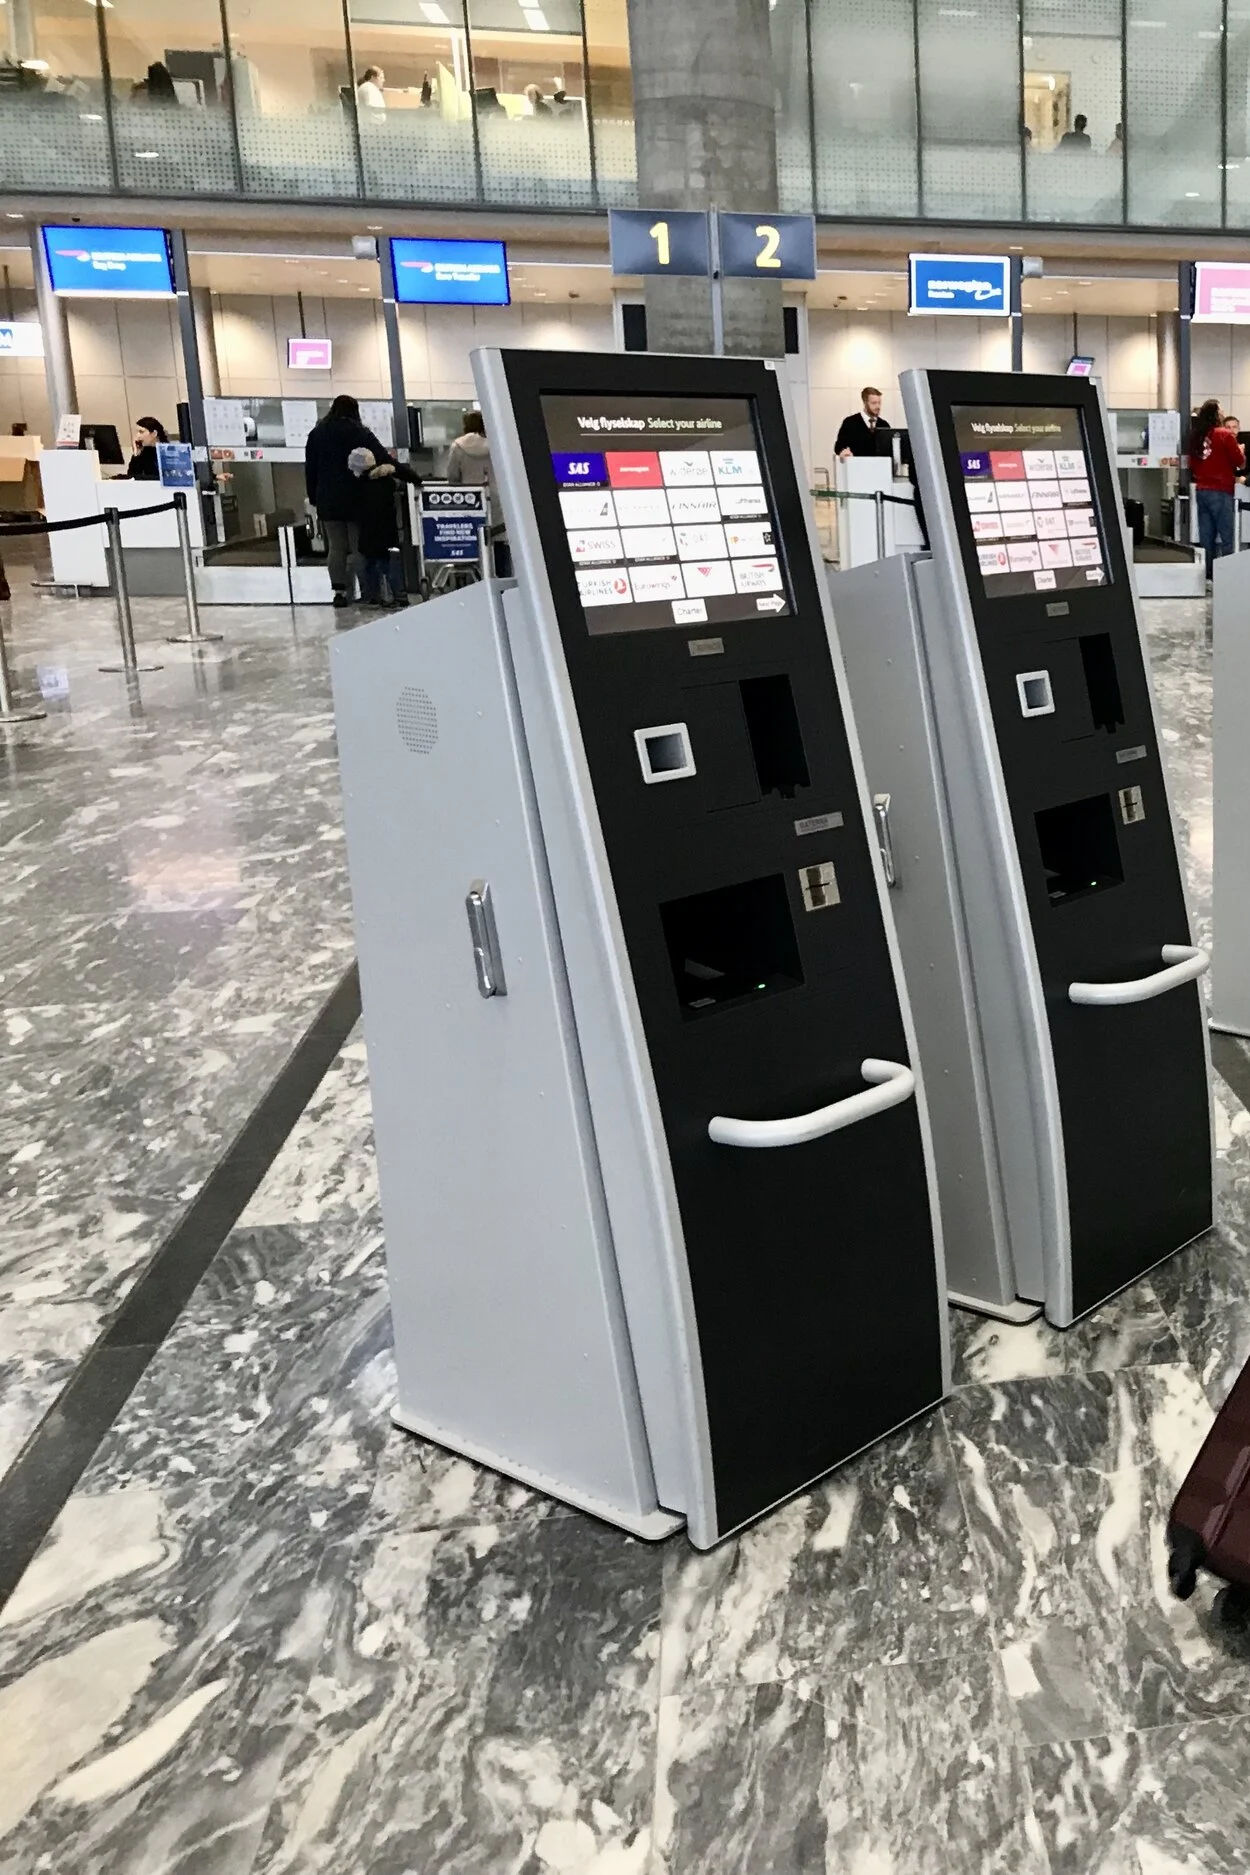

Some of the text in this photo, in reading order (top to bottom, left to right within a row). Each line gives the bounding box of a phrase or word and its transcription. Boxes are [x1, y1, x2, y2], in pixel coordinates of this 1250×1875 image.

[650, 222, 670, 265] 1
[755, 225, 781, 268] 2
[577, 417, 600, 430] Velg
[647, 417, 674, 429] Select
[675, 419, 695, 430] your
[696, 418, 722, 429] airline
[568, 462, 591, 475] SAS
[718, 466, 742, 475] KLM
[967, 459, 981, 470] SAS
